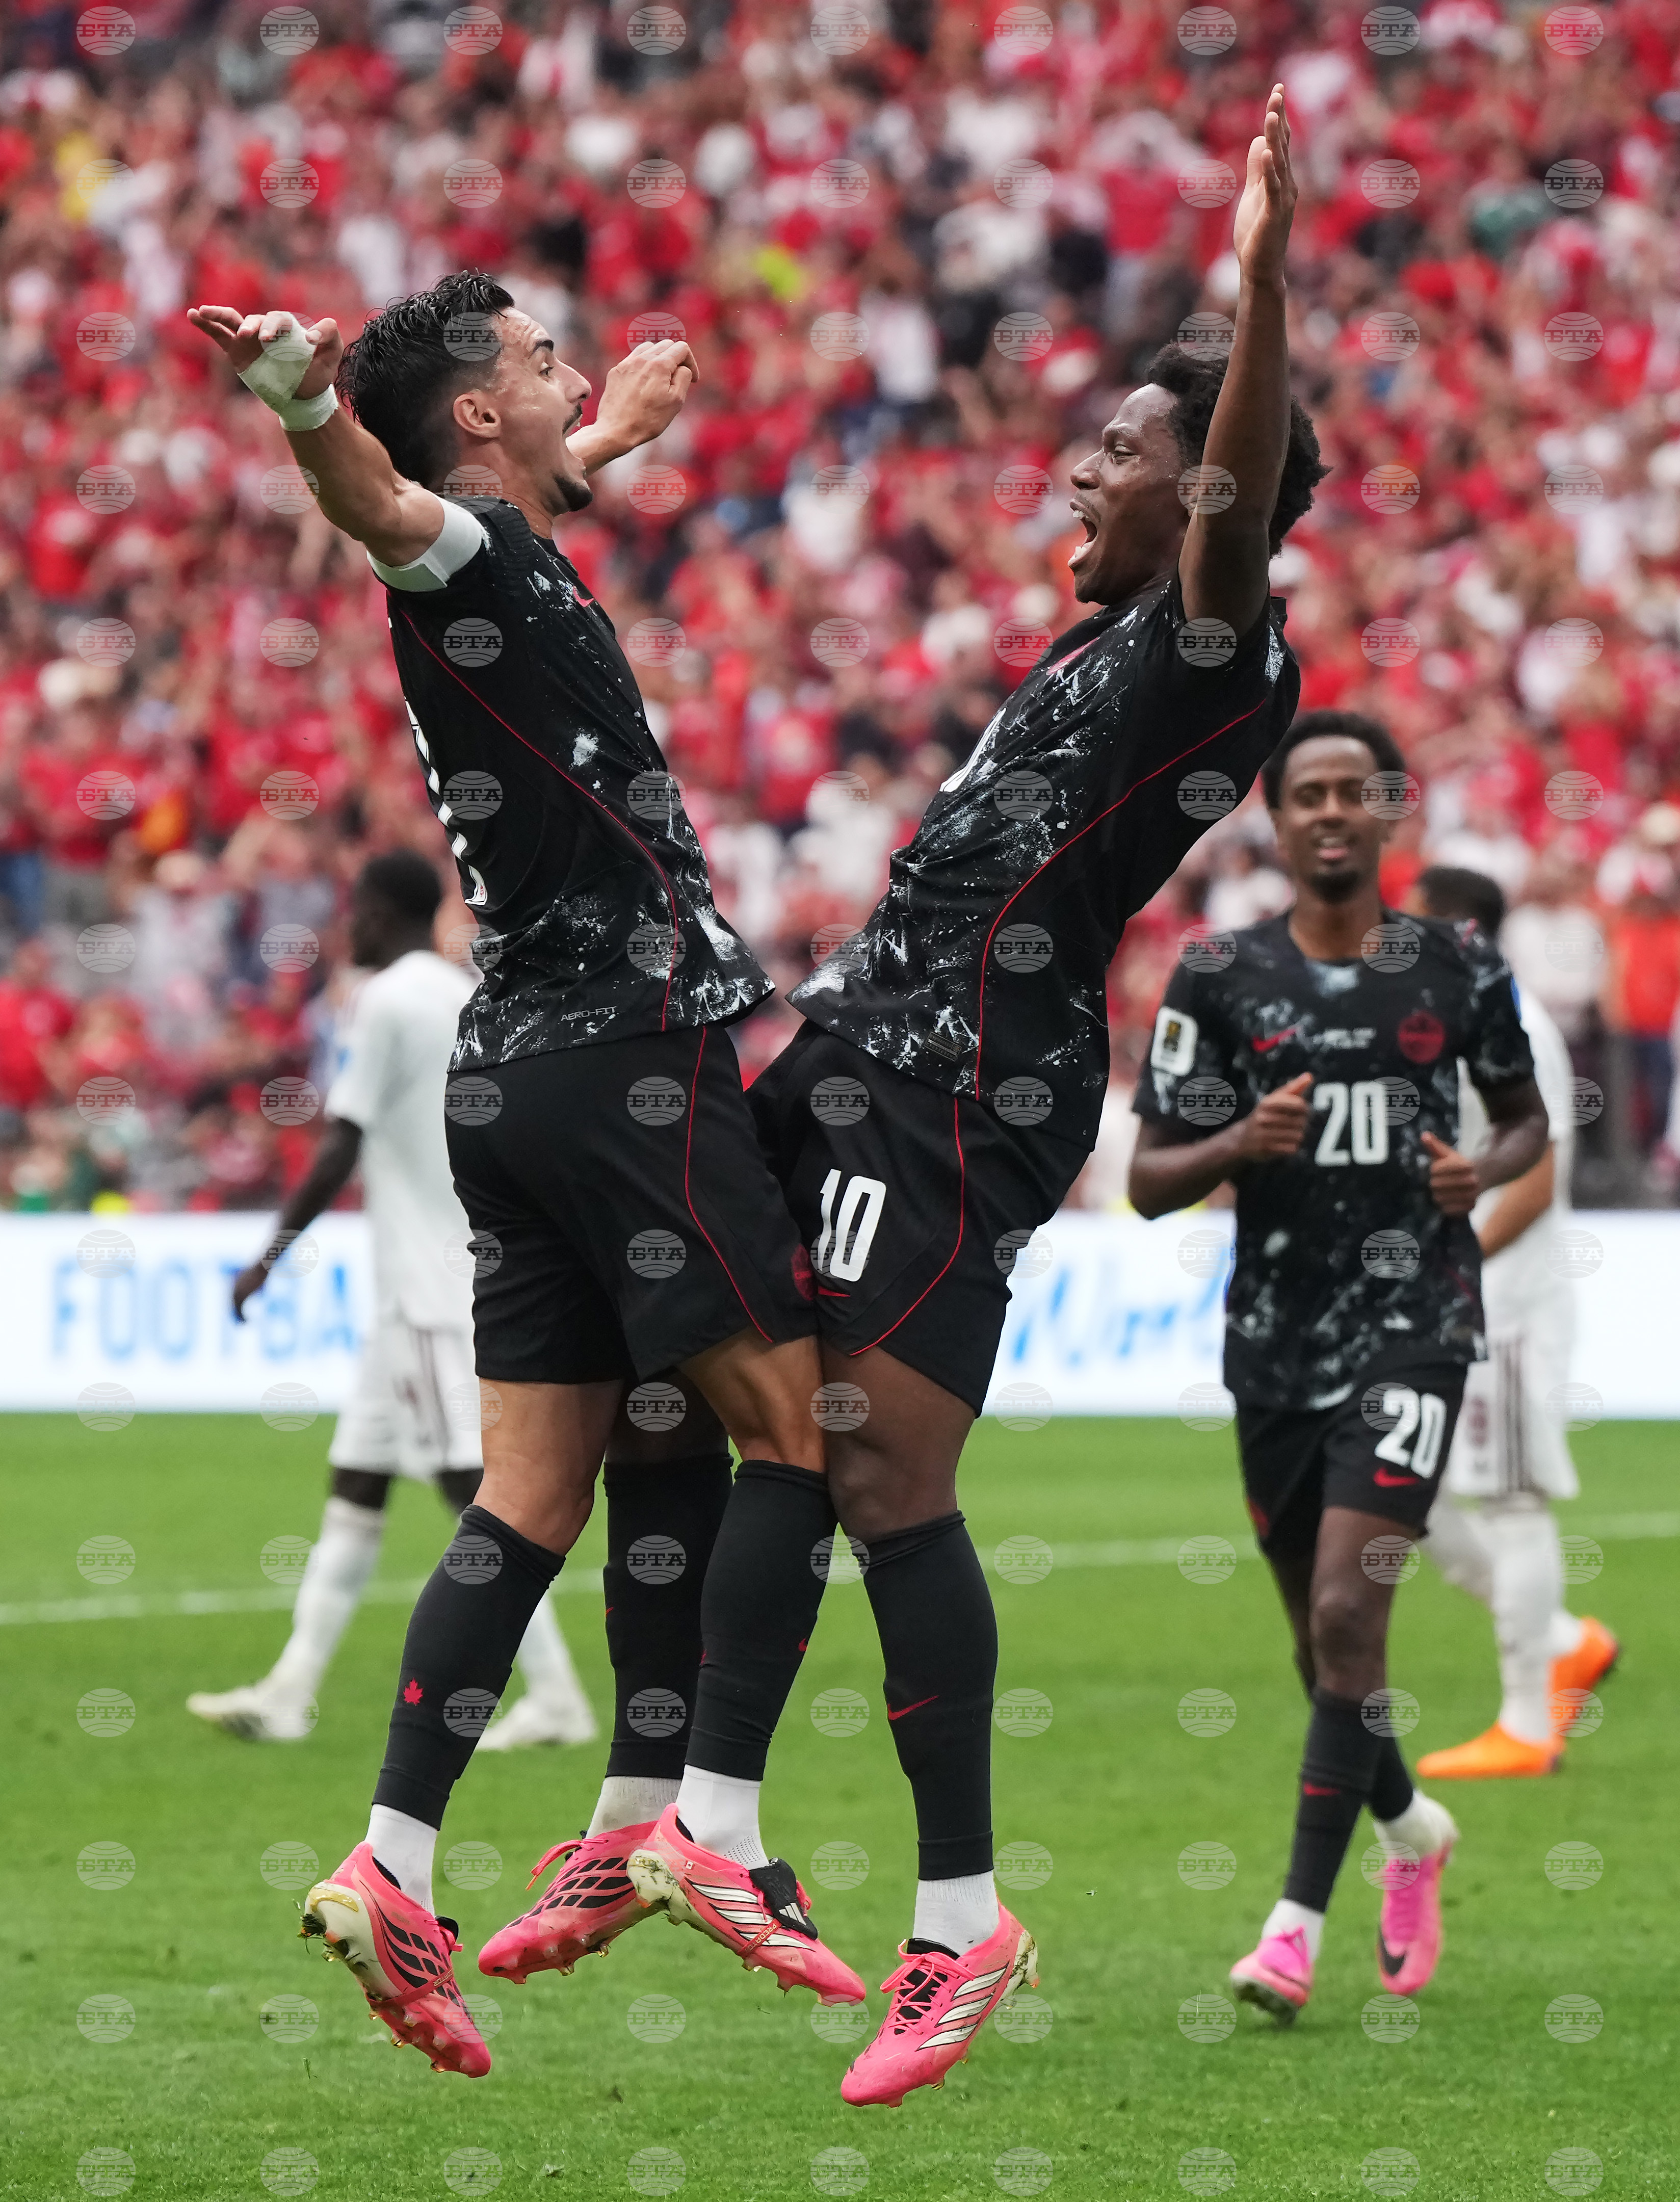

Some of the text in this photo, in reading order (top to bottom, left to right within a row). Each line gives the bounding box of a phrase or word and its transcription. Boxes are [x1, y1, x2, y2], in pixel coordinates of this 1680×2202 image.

[561, 1006, 617, 1021] AERO-FIT
[1312, 1081, 1390, 1167] 20
[820, 1168, 886, 1282] 10
[1374, 1388, 1448, 1480] 20
